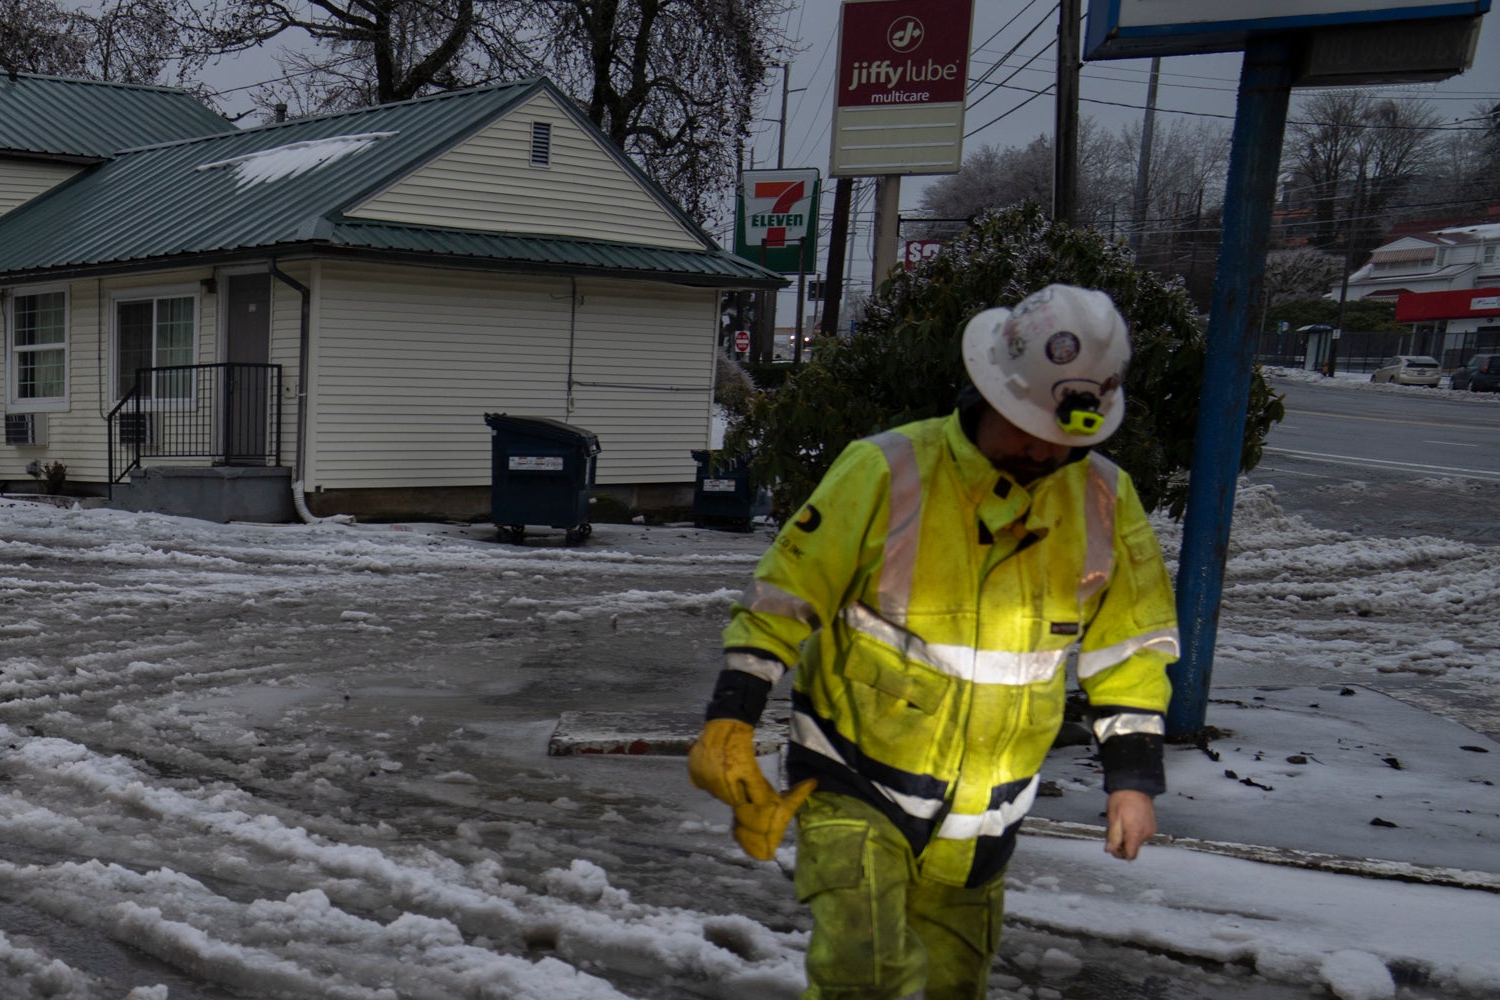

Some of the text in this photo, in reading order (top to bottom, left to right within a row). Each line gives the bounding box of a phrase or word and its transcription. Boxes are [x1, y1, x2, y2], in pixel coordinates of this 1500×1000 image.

[848, 58, 957, 91] jiffy lube
[871, 90, 930, 103] multicare
[754, 180, 805, 247] 7
